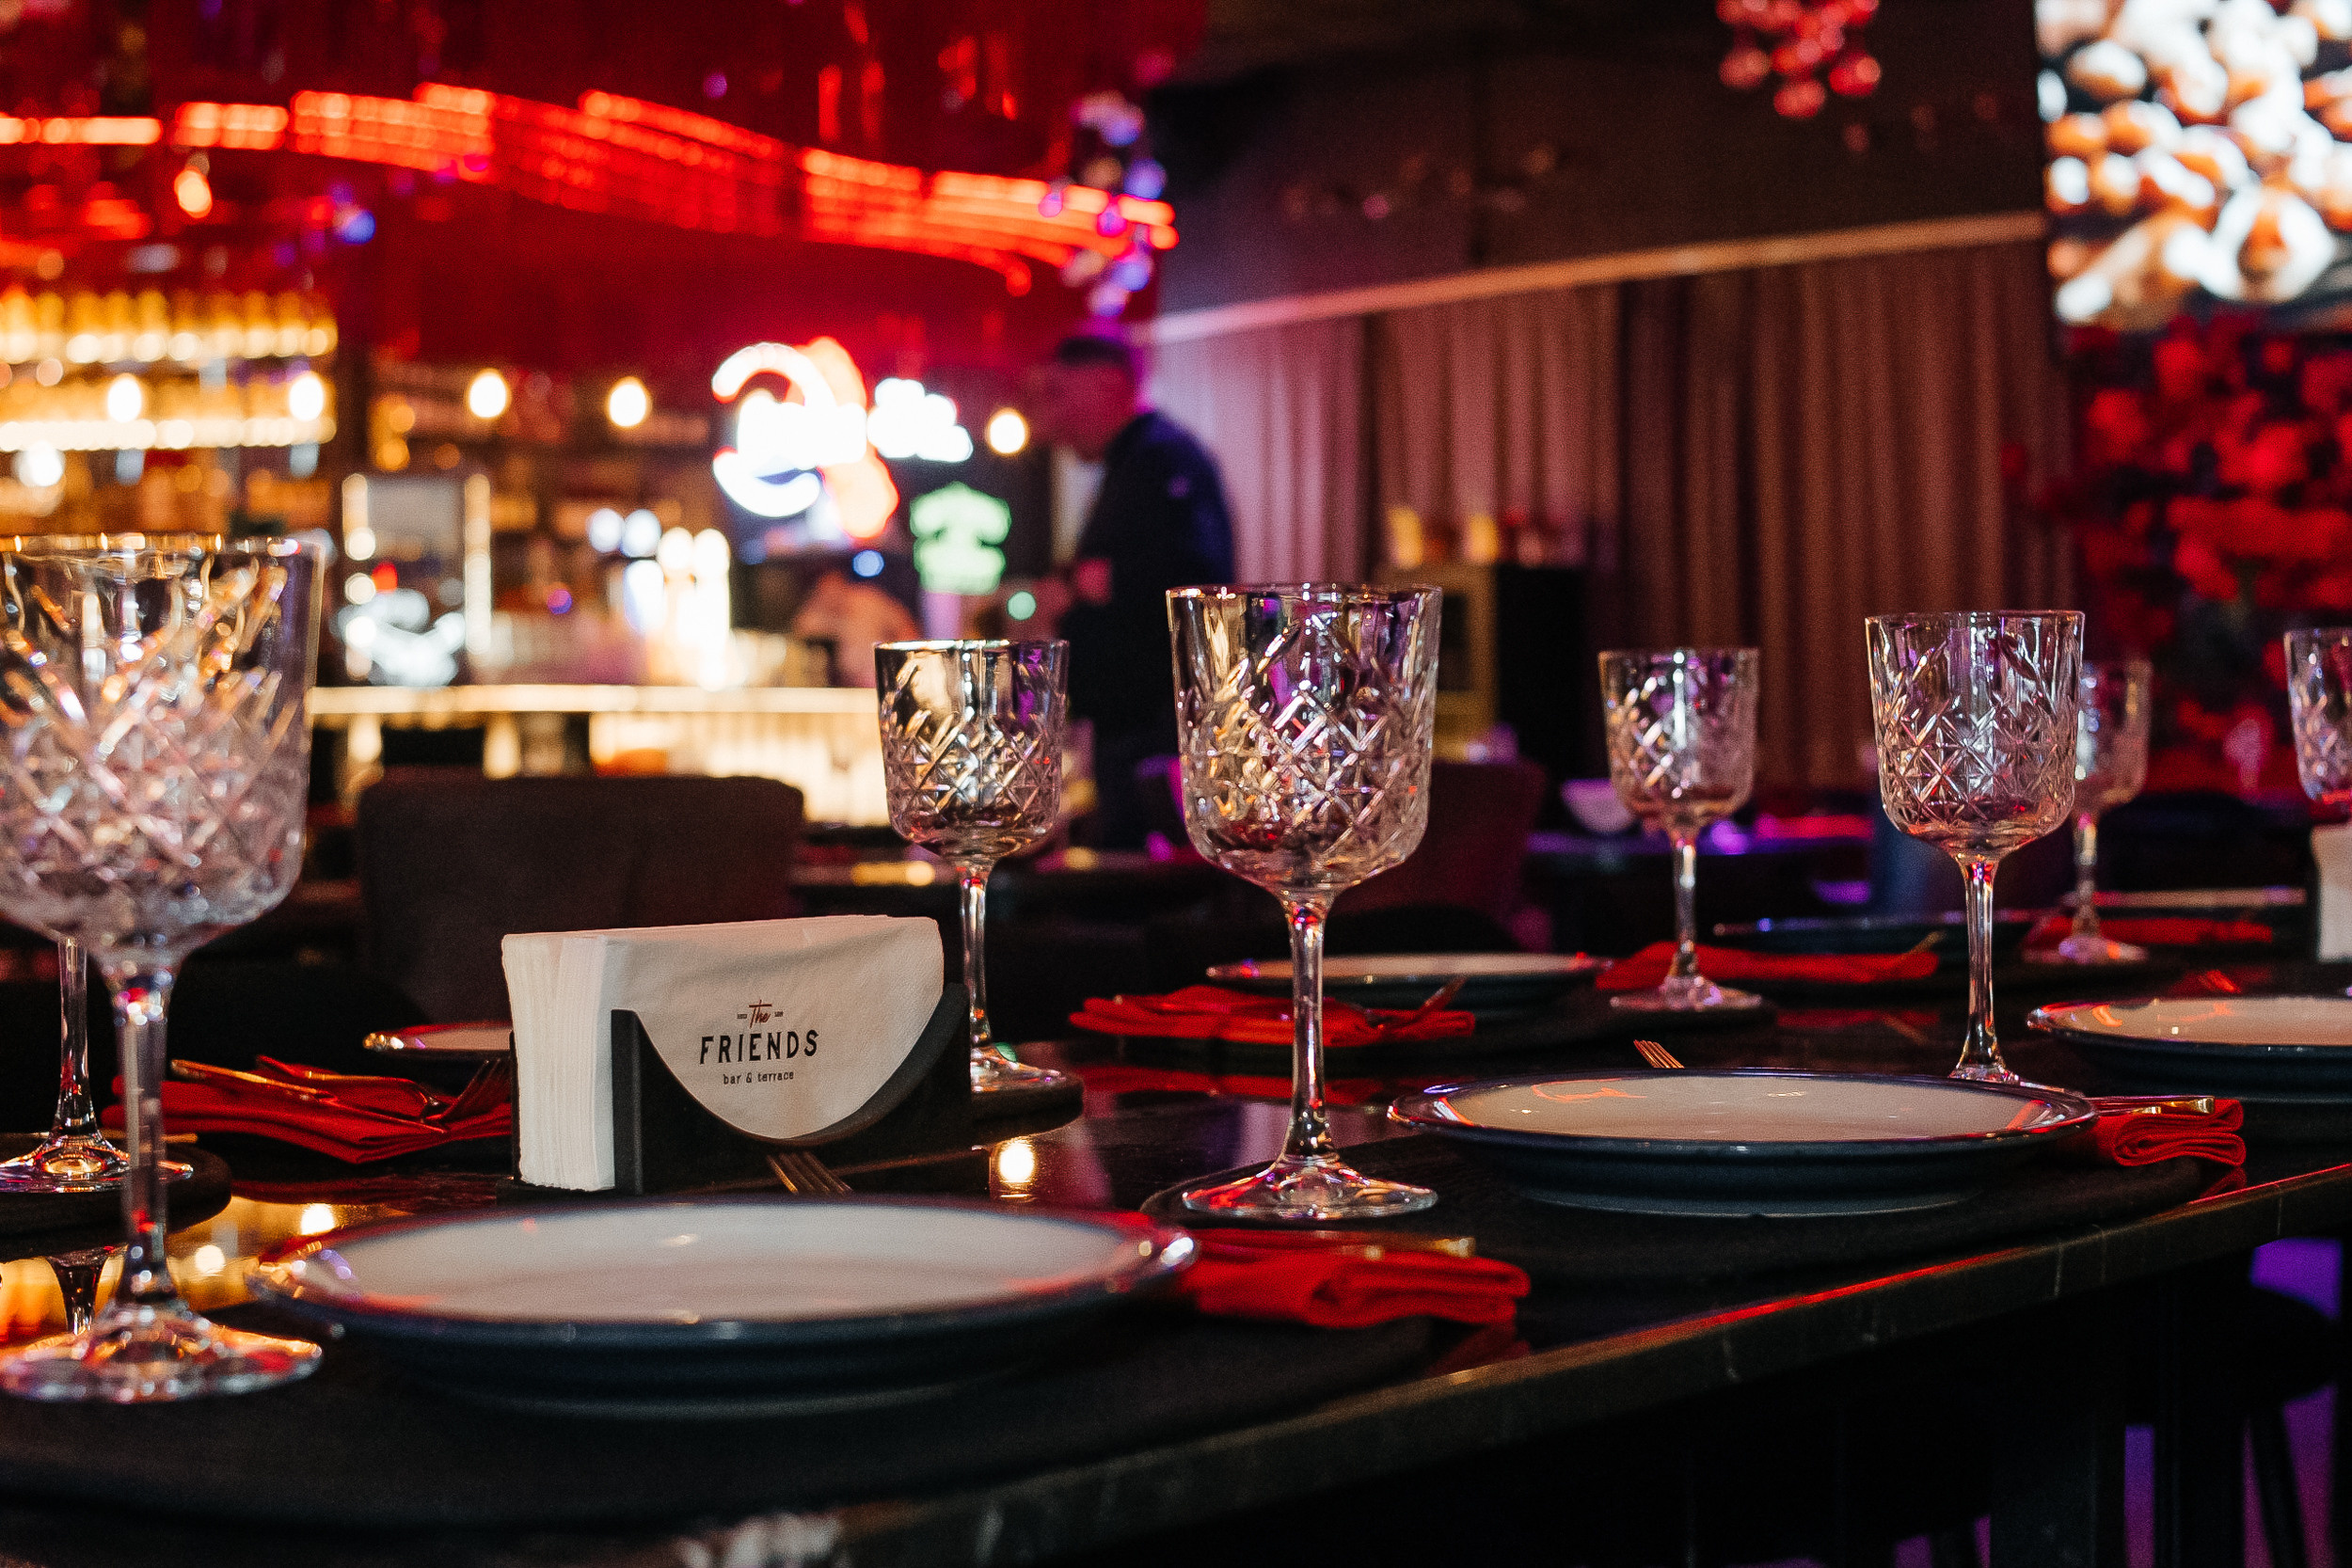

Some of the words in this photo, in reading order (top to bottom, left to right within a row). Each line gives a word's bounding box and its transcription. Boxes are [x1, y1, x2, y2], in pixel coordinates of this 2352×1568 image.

[748, 999, 772, 1029] The
[699, 1029, 819, 1065] FRIENDS
[723, 1073, 742, 1085] bar
[746, 1072, 753, 1084] &
[757, 1070, 794, 1083] terrace
